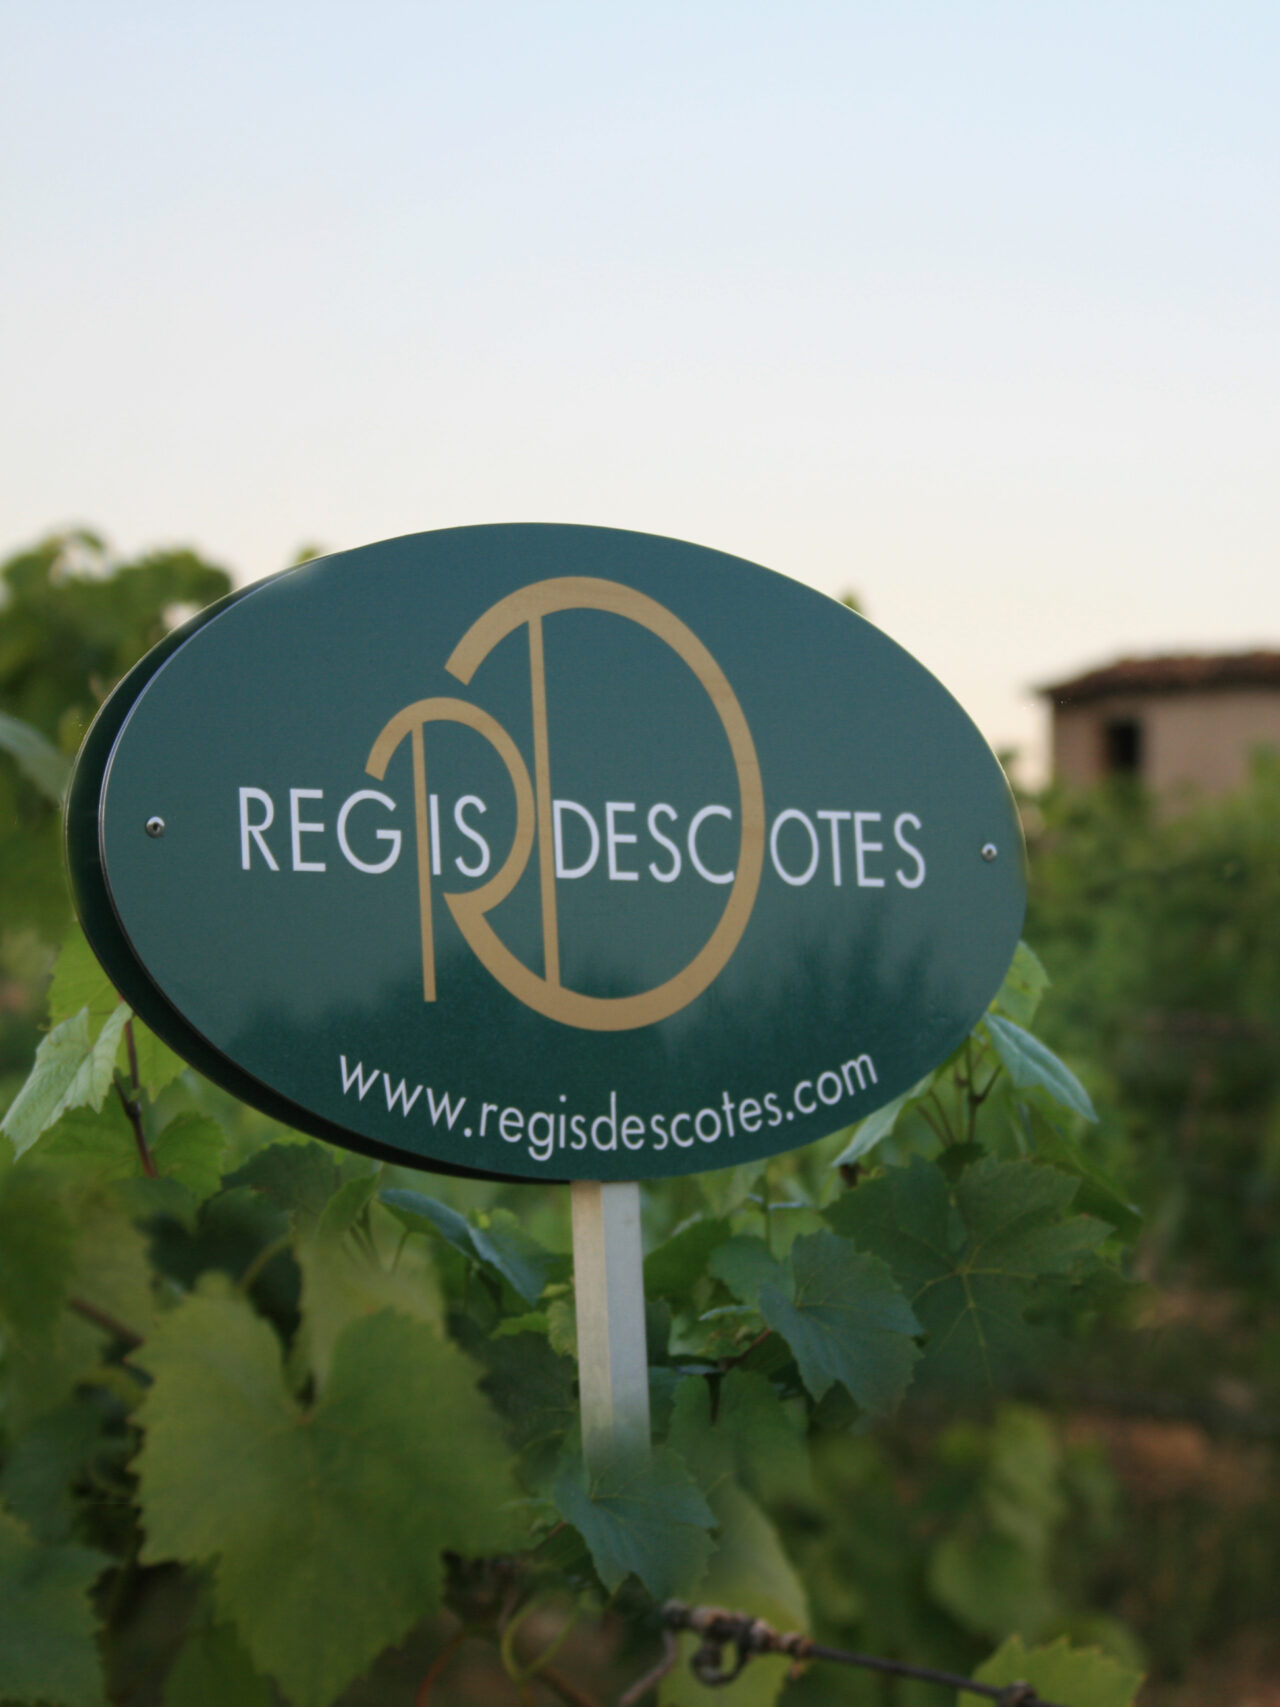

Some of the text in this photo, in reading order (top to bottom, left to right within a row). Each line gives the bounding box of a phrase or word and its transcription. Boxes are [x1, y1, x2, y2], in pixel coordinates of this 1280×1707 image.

[238, 786, 927, 889] REGIS DESCOTES
[339, 1052, 878, 1162] www.regisdescotes.com
